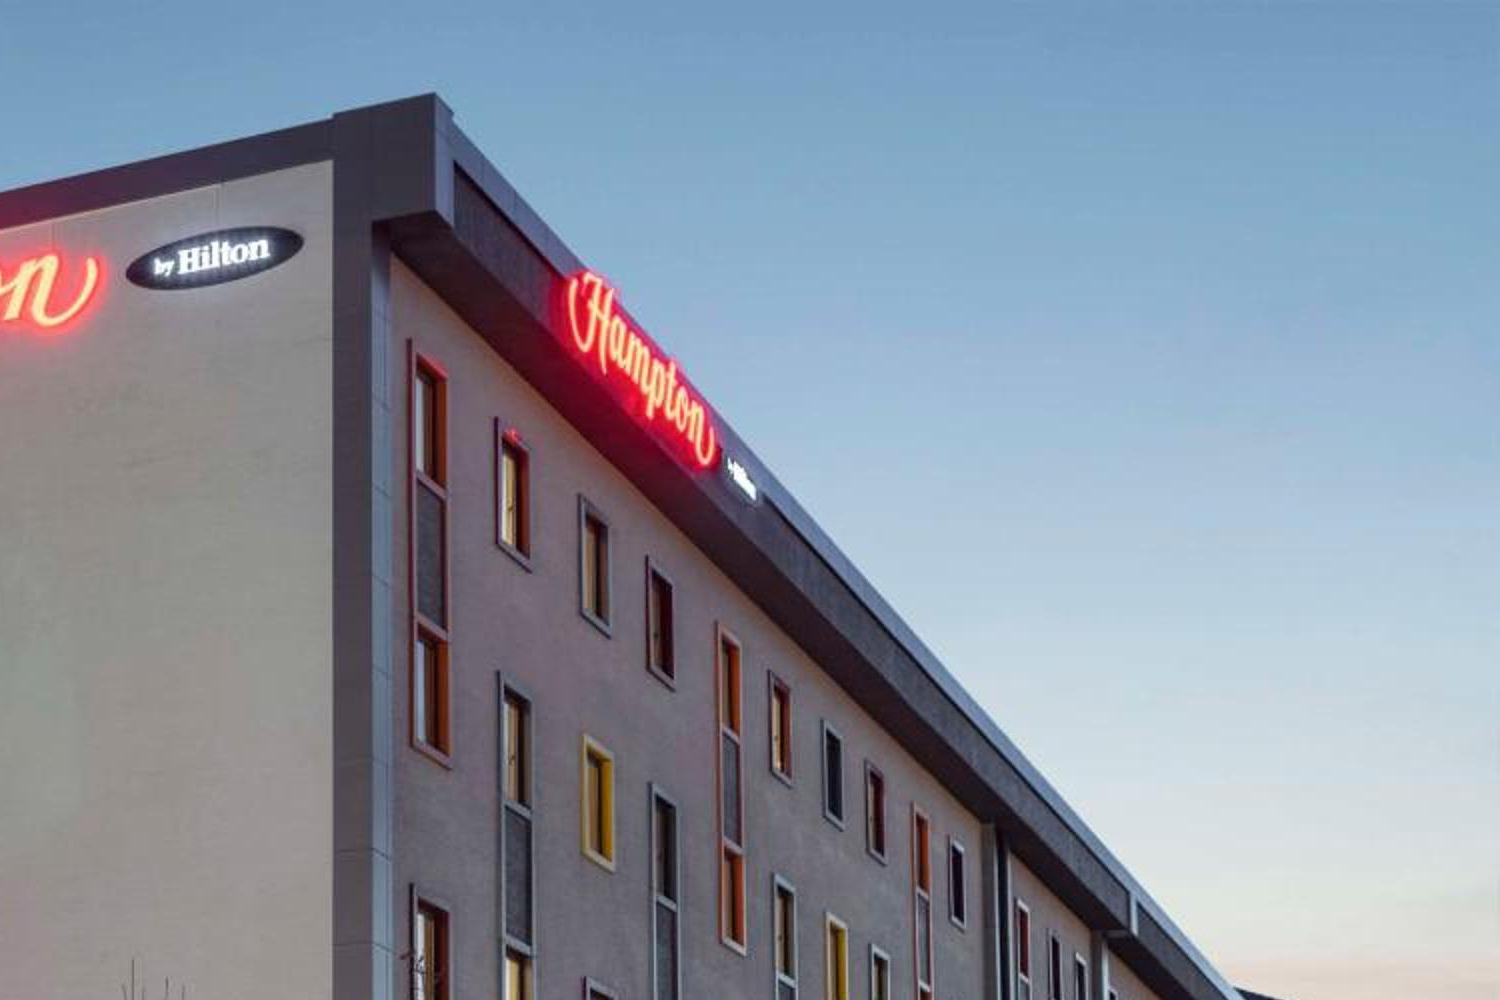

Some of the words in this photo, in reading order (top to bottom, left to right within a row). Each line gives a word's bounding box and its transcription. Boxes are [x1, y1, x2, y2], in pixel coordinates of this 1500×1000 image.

[153, 257, 175, 277] by
[177, 239, 270, 275] Hilton
[567, 271, 716, 466] Hampton
